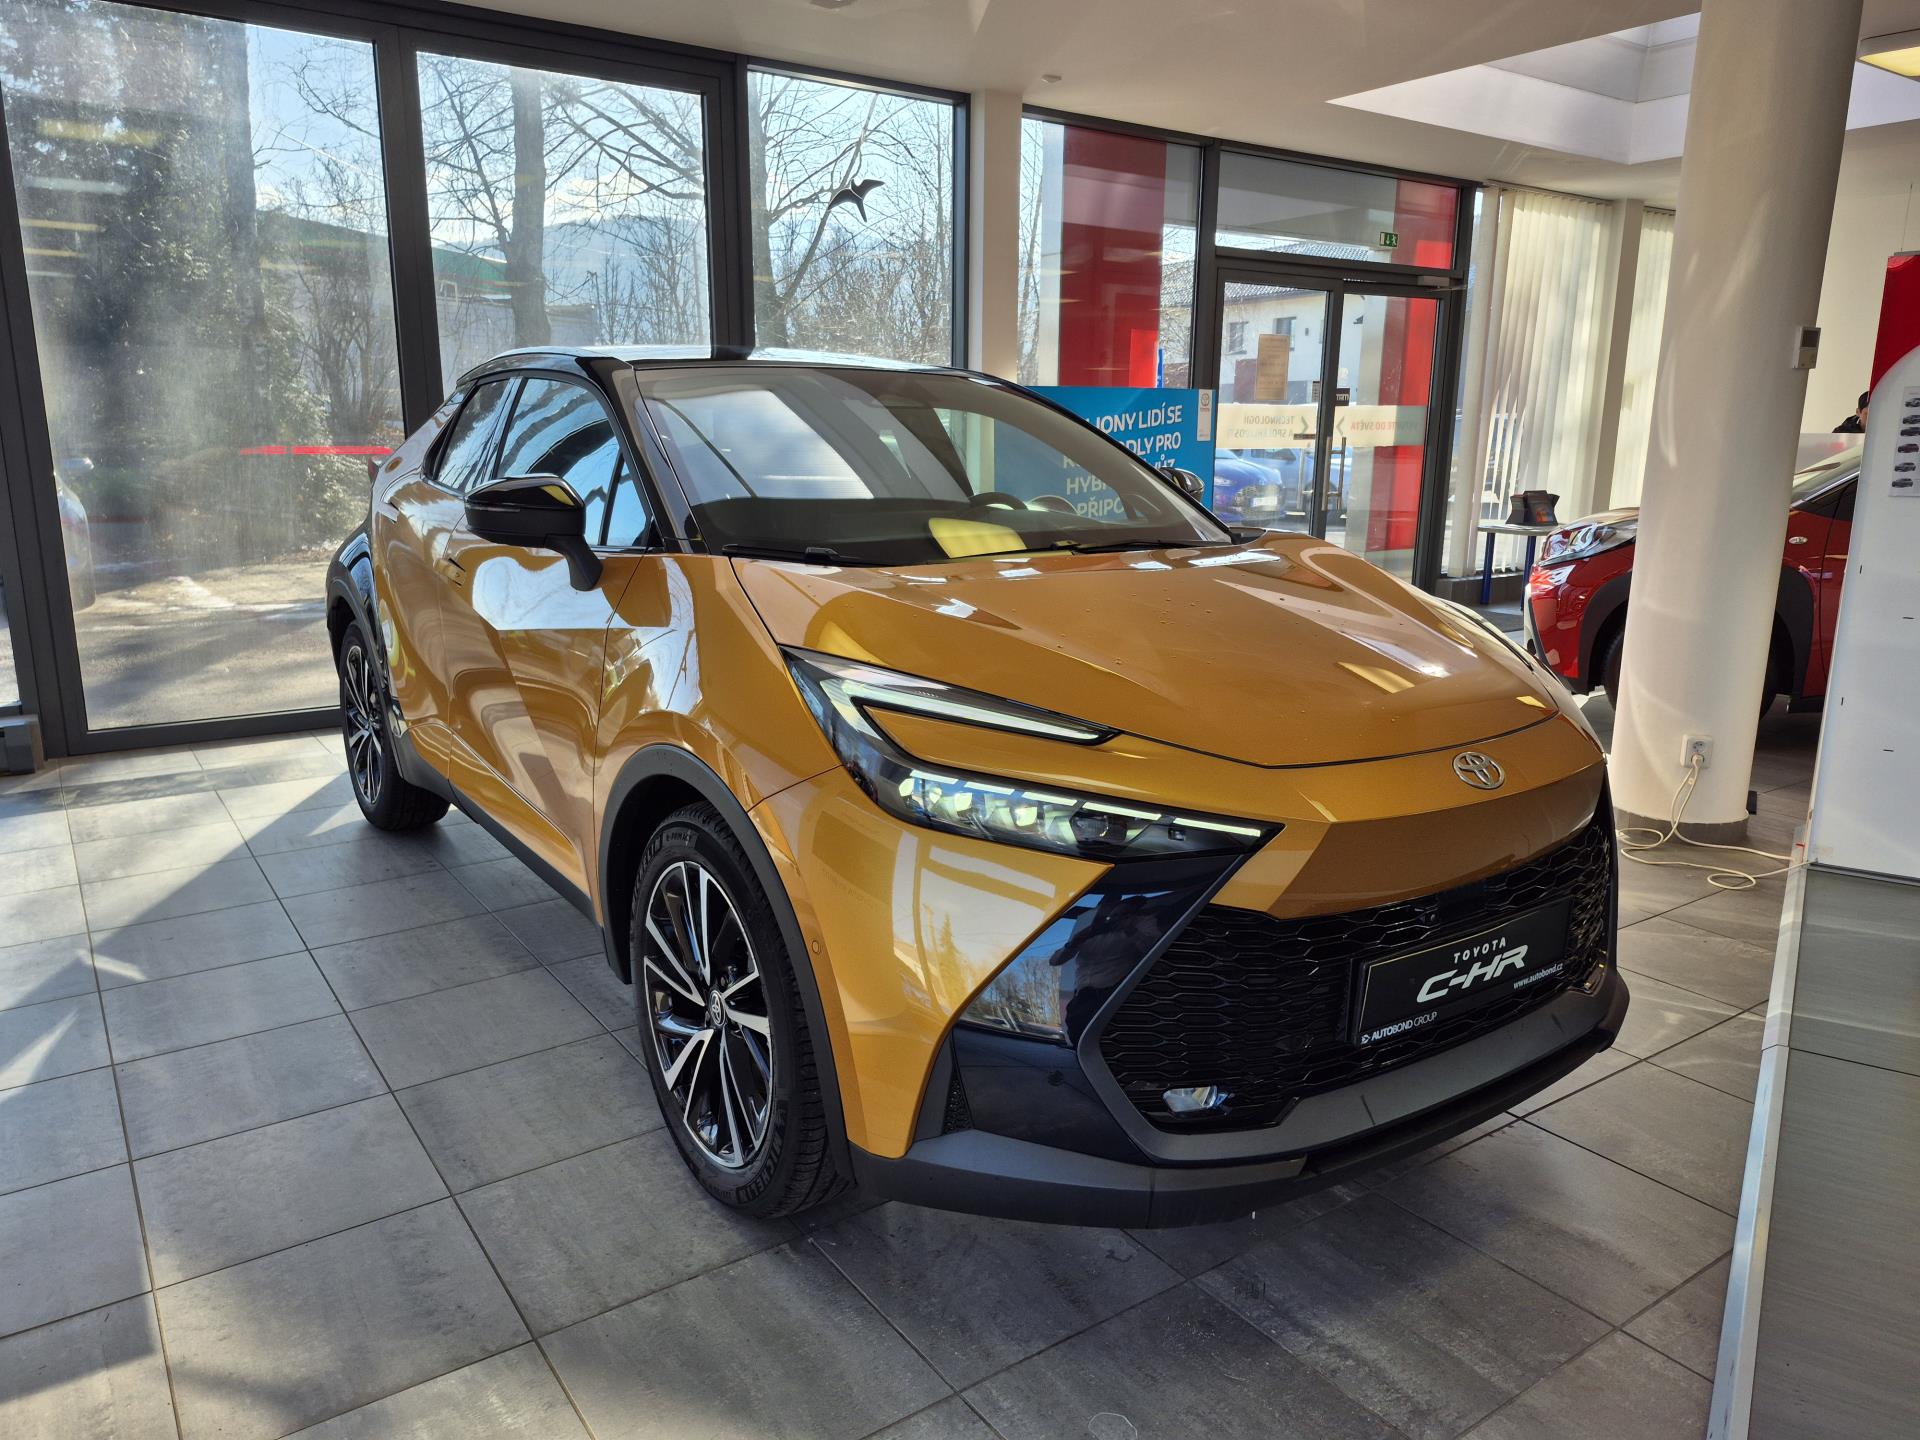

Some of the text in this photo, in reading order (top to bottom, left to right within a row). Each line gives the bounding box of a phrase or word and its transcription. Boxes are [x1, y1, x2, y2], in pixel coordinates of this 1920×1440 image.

[1086, 401, 1183, 434] IONY LIDÍ SE
[1155, 431, 1182, 453] PRO
[1453, 937, 1506, 964] TOYOTA
[1416, 944, 1529, 1003] C-HR
[1513, 962, 1564, 990] www.autobond.cz
[1371, 1011, 1438, 1041] AUTOBOND GROUP
